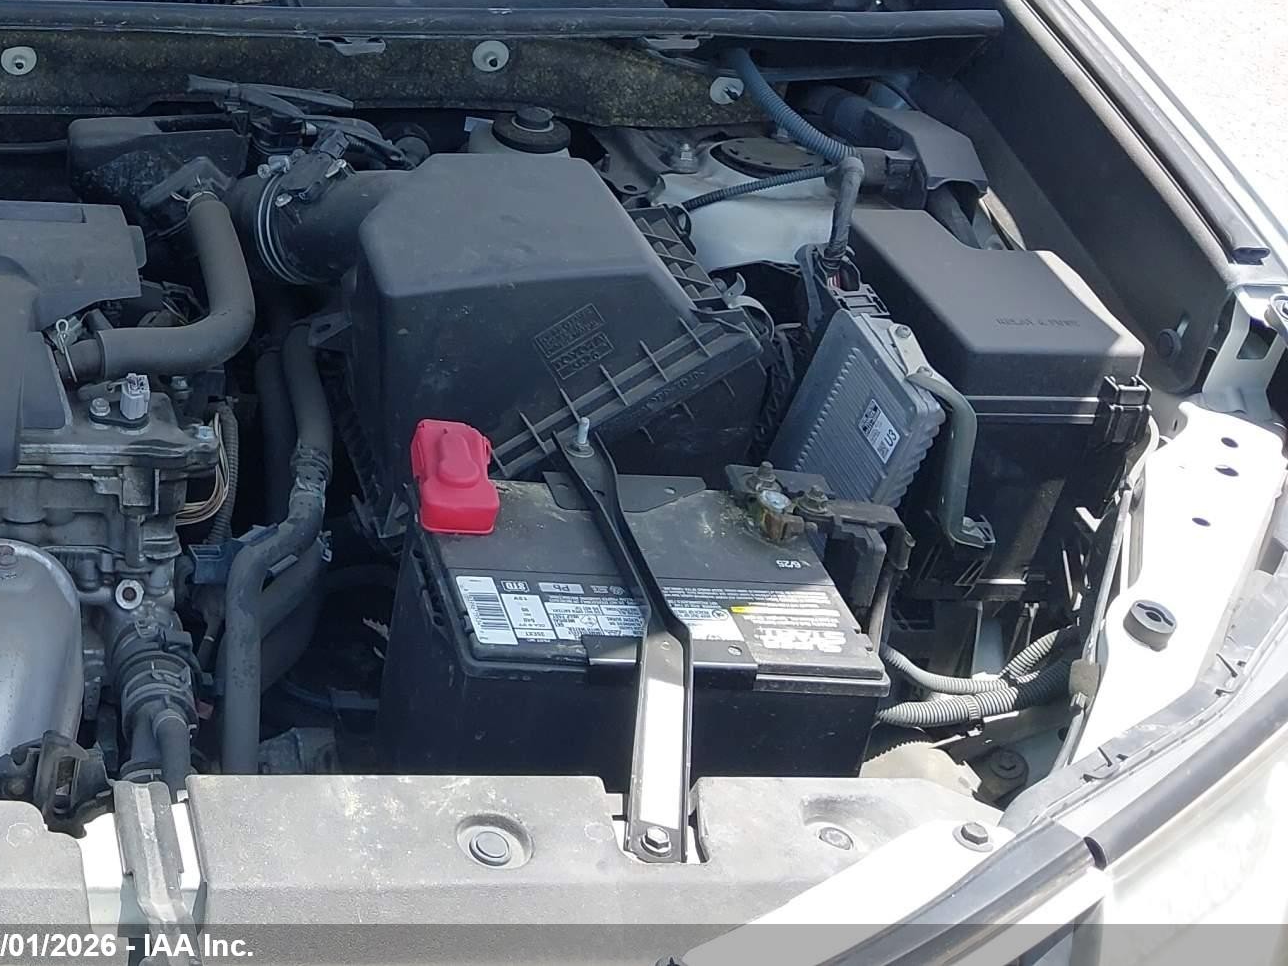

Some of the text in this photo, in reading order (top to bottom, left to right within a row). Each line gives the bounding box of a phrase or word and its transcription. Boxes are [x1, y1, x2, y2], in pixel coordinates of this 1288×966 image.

[884, 429, 898, 447] U3
[505, 582, 526, 590] STD
[552, 584, 570, 592] Pb
